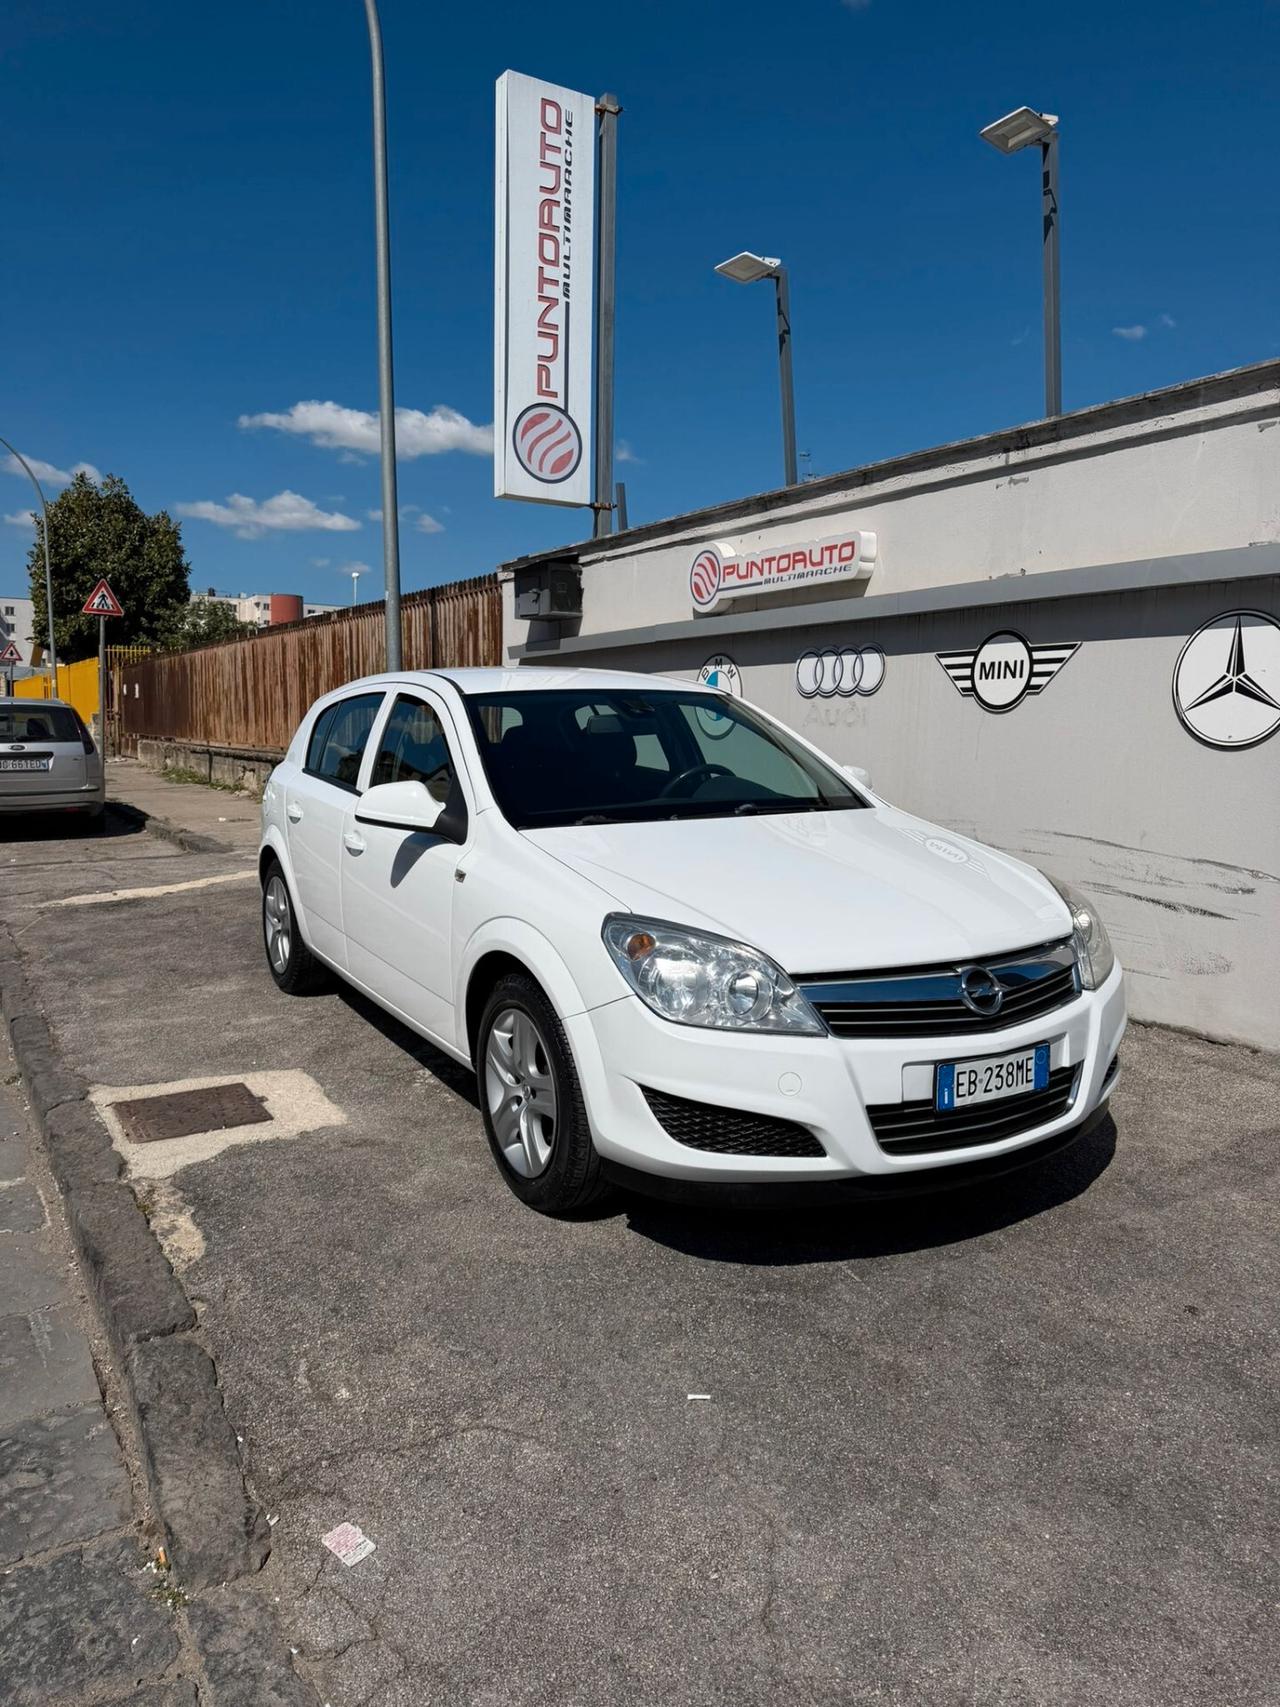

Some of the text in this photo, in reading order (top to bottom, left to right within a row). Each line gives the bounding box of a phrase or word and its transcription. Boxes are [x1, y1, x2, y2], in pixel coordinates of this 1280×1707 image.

[563, 109, 574, 300] MULTIMARCHE
[537, 97, 562, 399] PUNTOAUTO
[722, 540, 856, 583] PUNTOAUTO
[763, 564, 853, 585] MULTIMARCHE
[702, 658, 737, 680] BMW
[979, 659, 1025, 681] MINI
